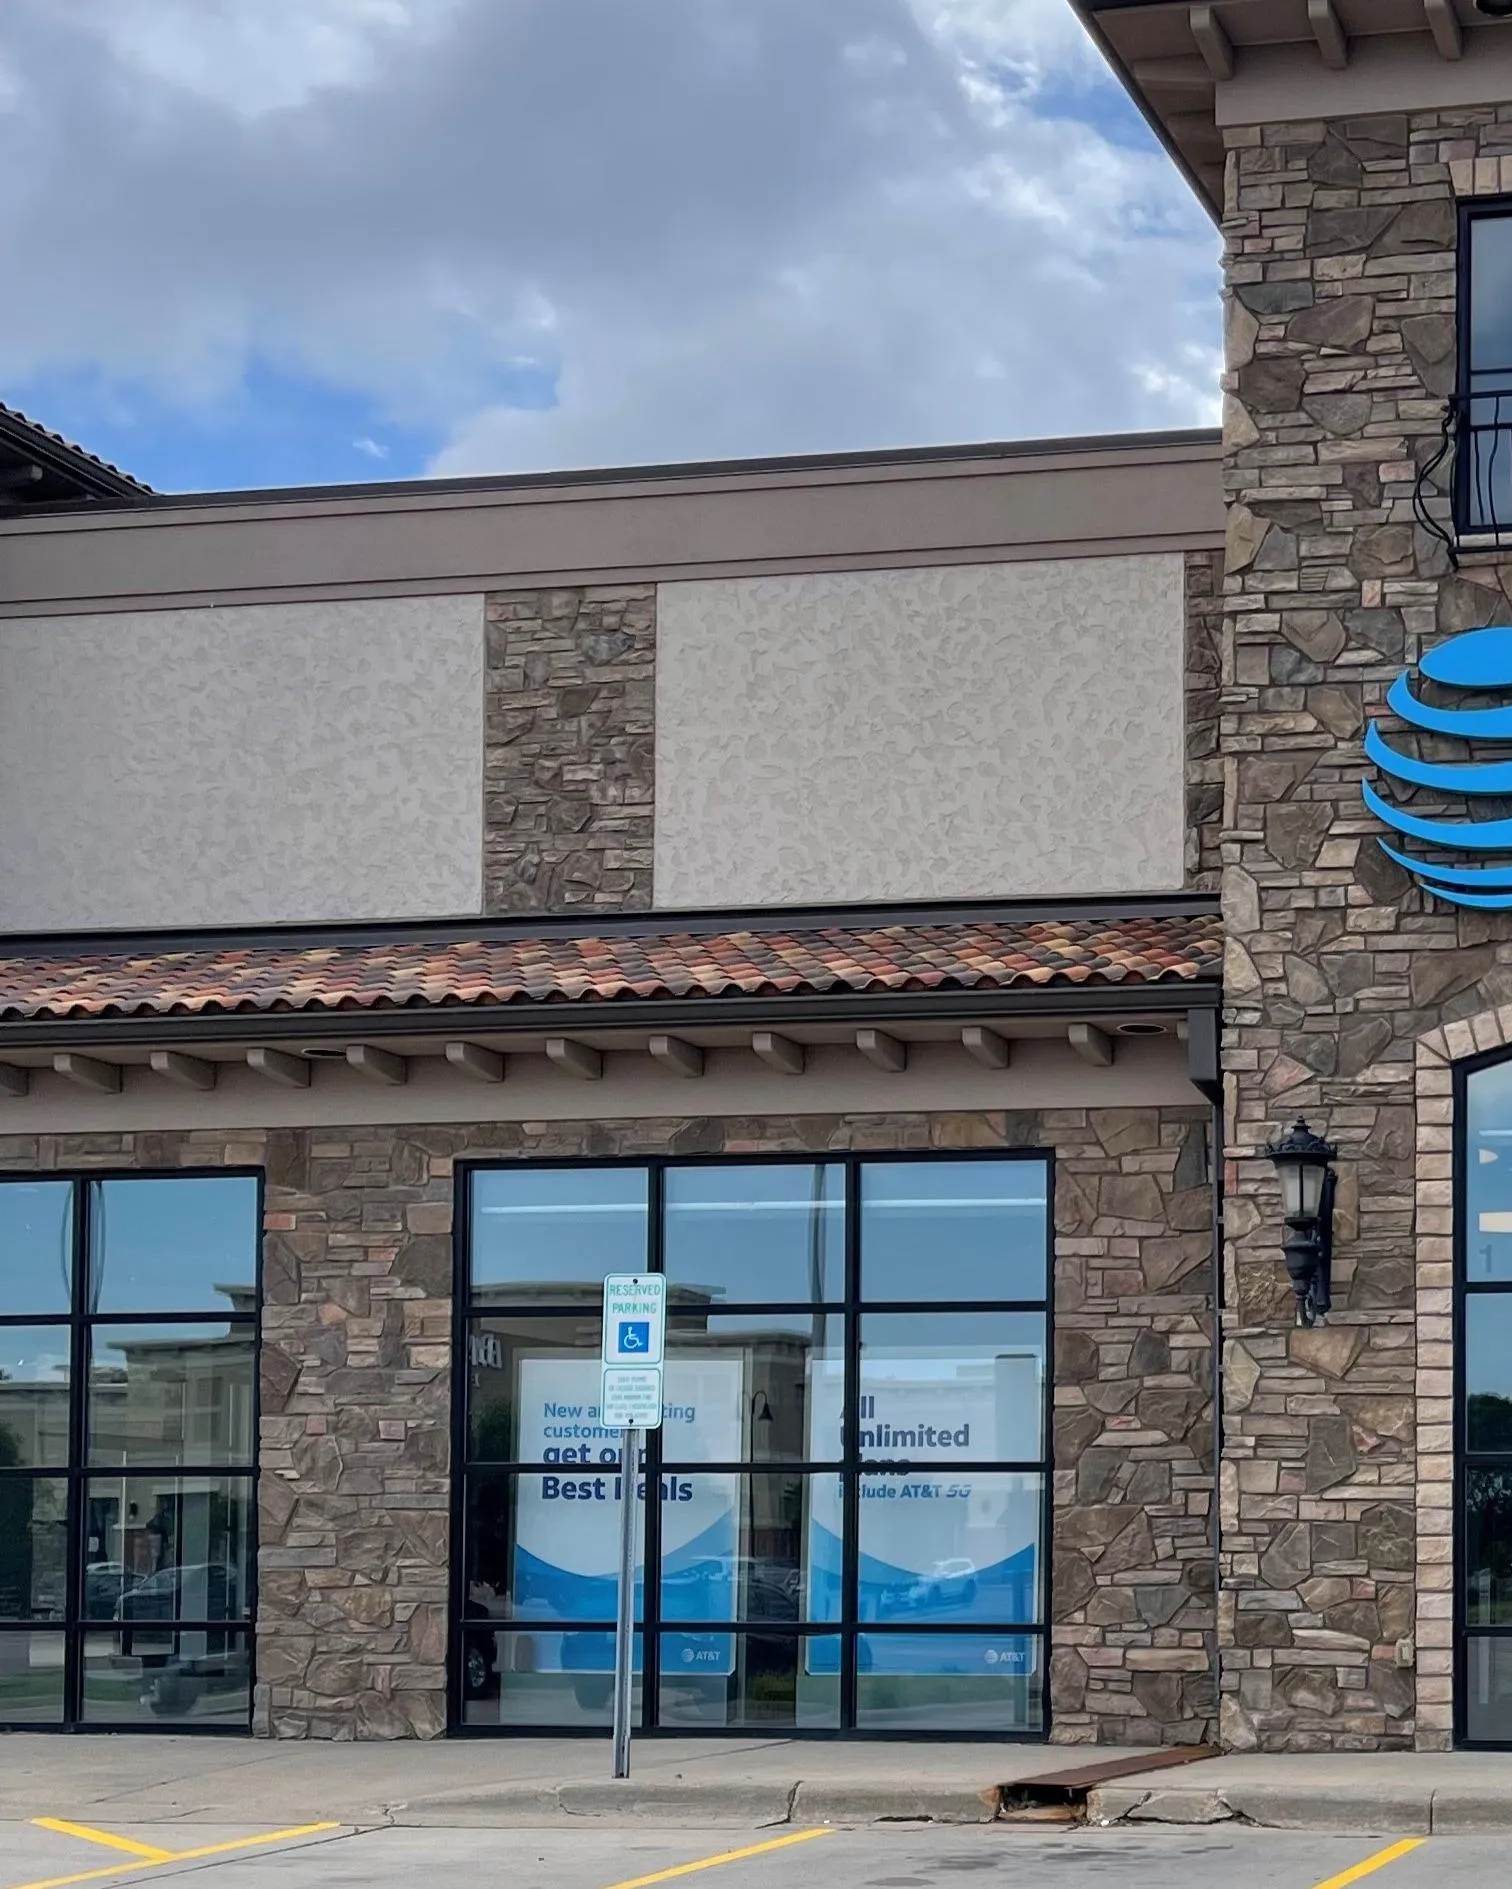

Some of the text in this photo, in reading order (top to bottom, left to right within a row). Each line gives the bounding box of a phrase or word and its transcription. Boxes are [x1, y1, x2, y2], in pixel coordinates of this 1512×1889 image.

[608, 1284, 660, 1296] RESERVED
[612, 1303, 657, 1314] PARKING
[544, 1403, 582, 1418] New
[840, 1395, 875, 1419] ll
[840, 1423, 970, 1448] nlimited
[541, 1476, 606, 1500] Best
[900, 1484, 943, 1498] AT&T
[695, 1651, 720, 1660] AT&T
[1000, 1651, 1025, 1662] AT&T
